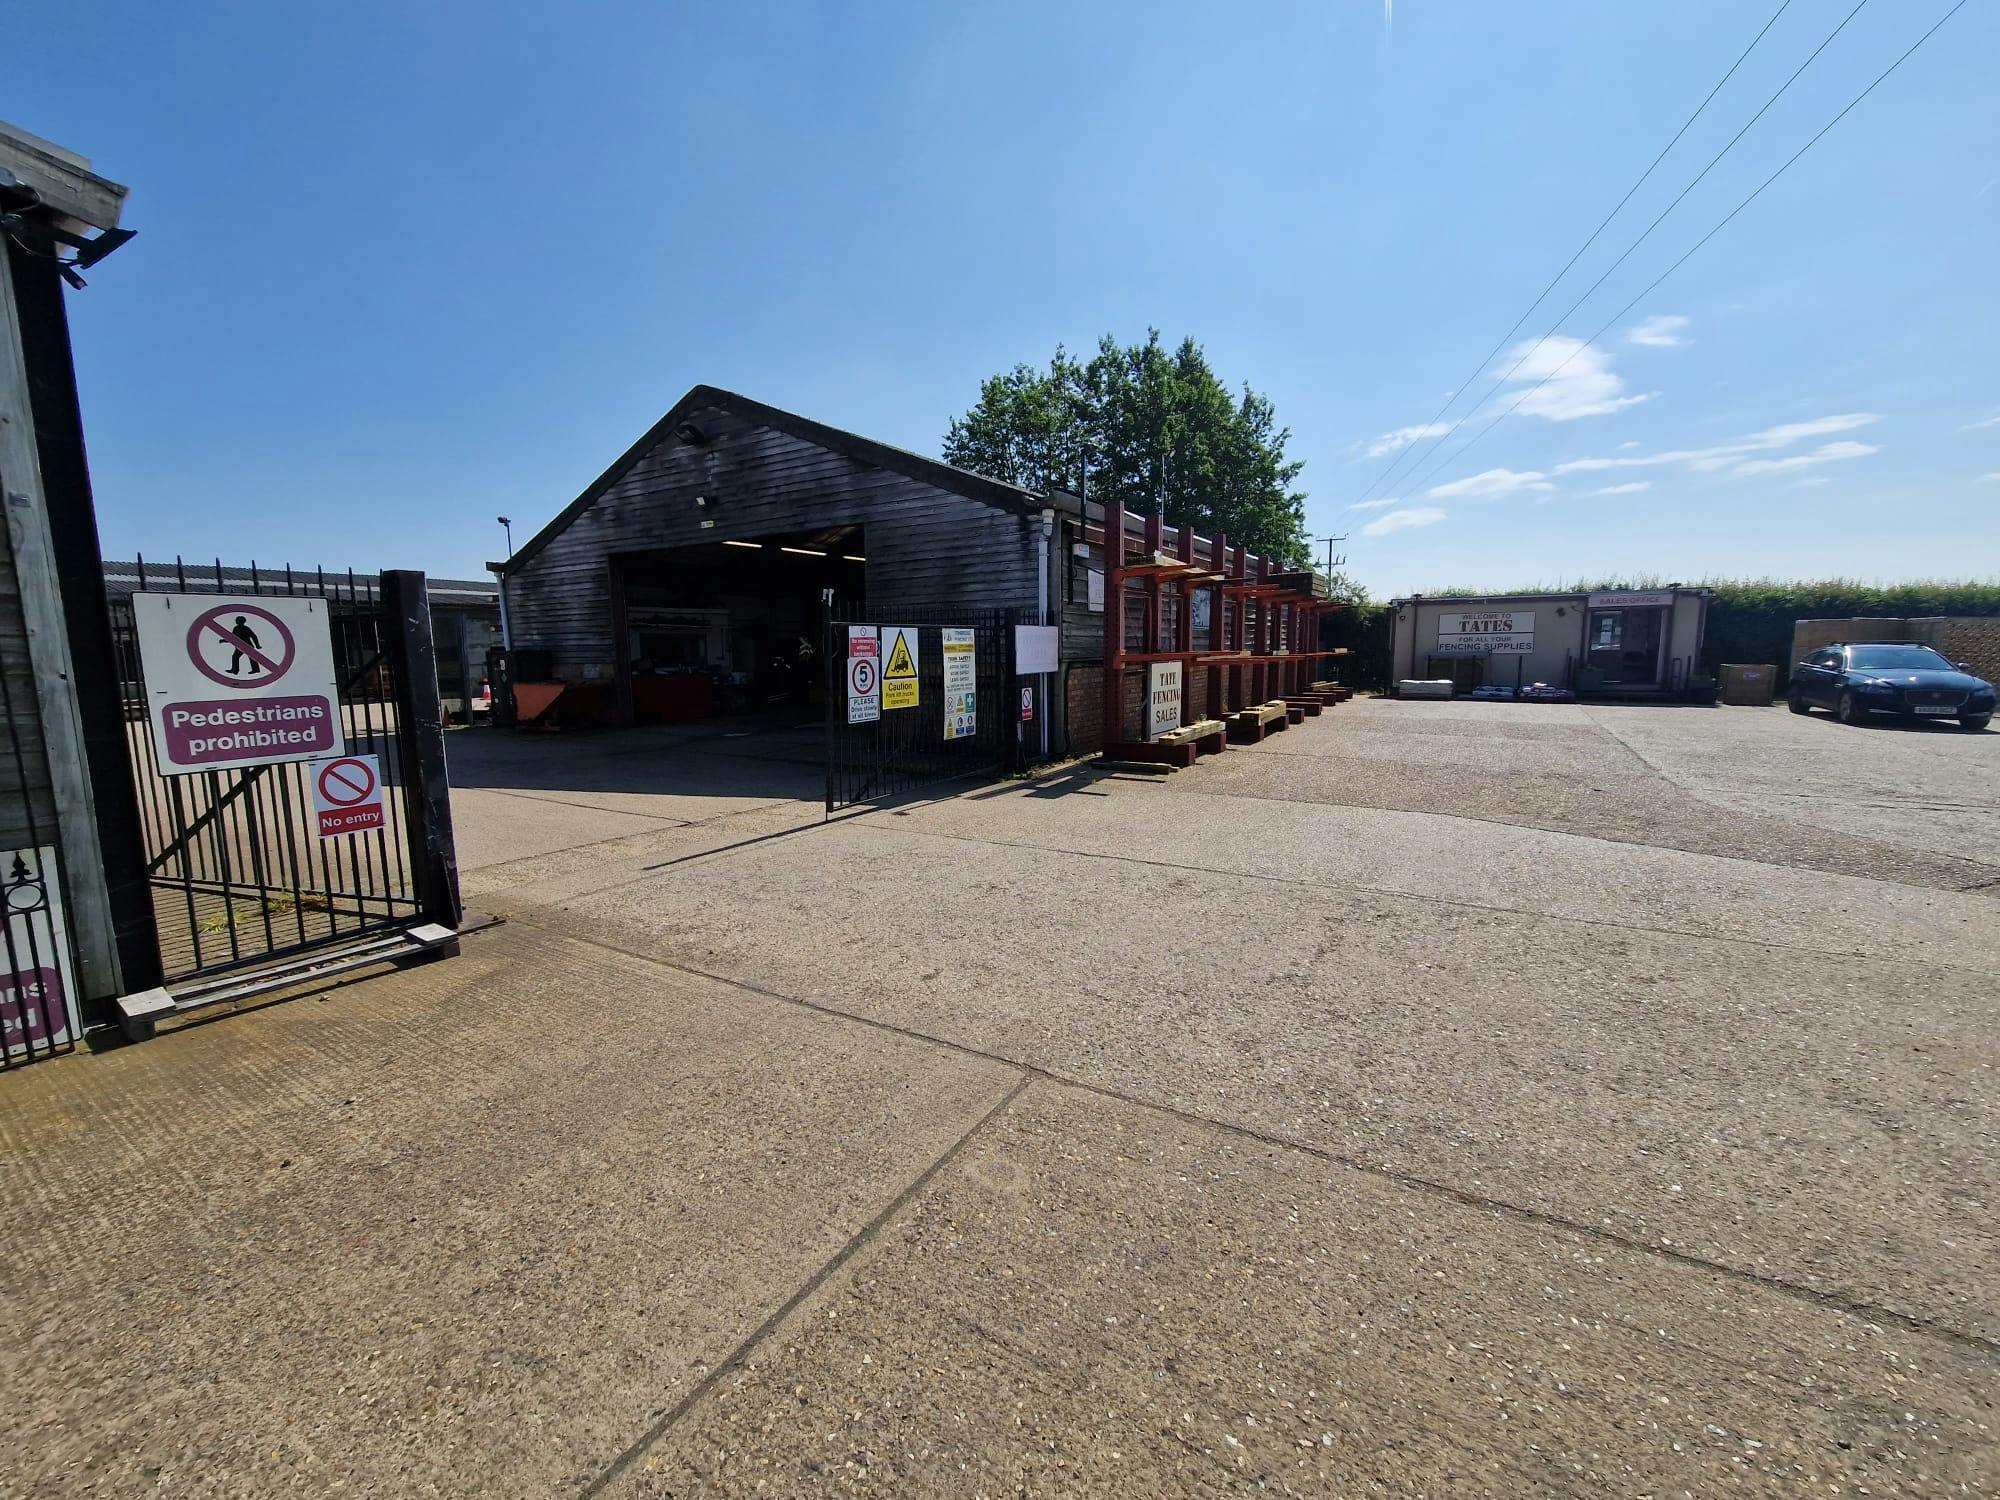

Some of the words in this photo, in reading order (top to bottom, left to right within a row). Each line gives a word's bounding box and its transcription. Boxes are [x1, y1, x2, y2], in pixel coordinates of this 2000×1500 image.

[1600, 597, 1628, 605] SALES
[1629, 596, 1660, 604] OFFICE
[1458, 619, 1513, 632] TATES
[1439, 643, 1481, 651] FENCING
[1484, 642, 1532, 650] SUPPLIES
[859, 666, 868, 683] 5
[1160, 672, 1177, 686] TATE
[888, 682, 913, 691] Caution
[853, 697, 874, 706] PLEASE
[1152, 688, 1180, 705] FENCING
[171, 704, 324, 728] Pedestrians
[1156, 707, 1177, 723] SALES
[189, 726, 317, 756] prohibited
[322, 817, 344, 829] No
[345, 811, 380, 825] entry
